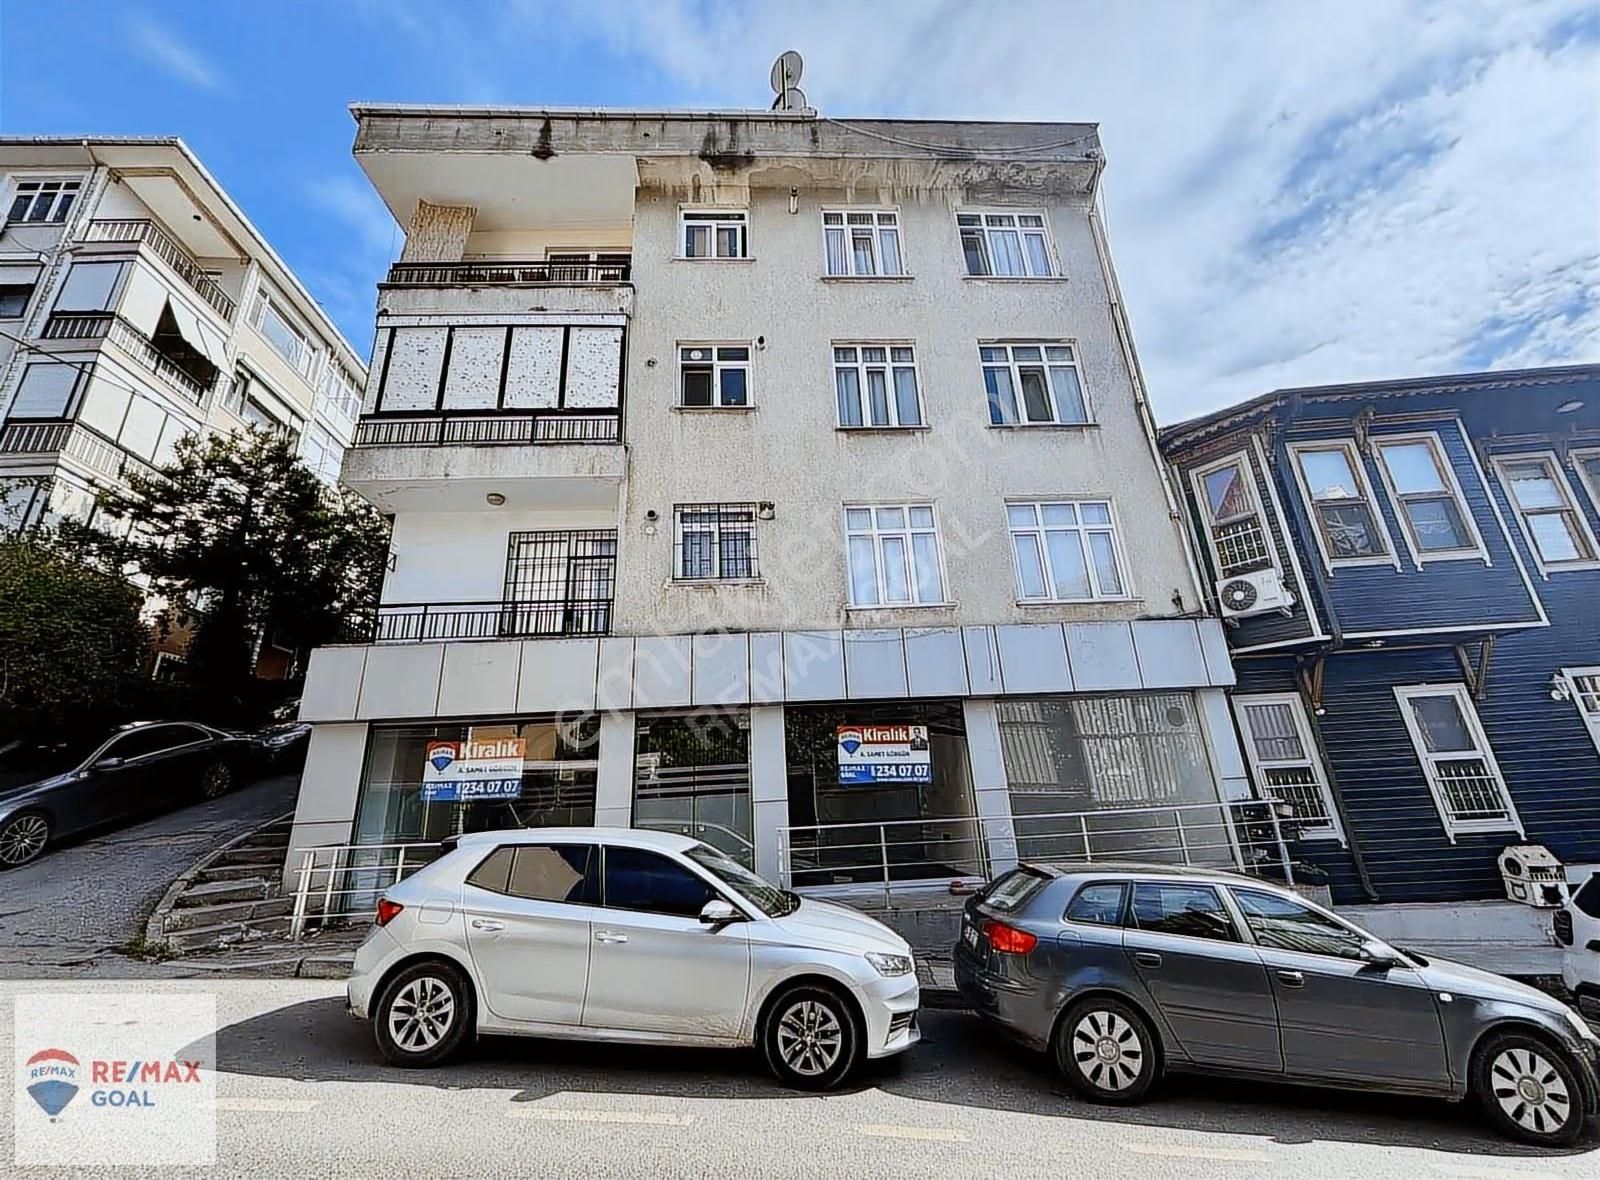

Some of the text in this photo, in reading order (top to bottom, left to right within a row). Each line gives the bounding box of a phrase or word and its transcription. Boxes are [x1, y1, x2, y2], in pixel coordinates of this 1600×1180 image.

[898, 765, 913, 777] 07
[914, 765, 928, 777] 07
[487, 781, 501, 793] 07
[503, 780, 519, 792] 07
